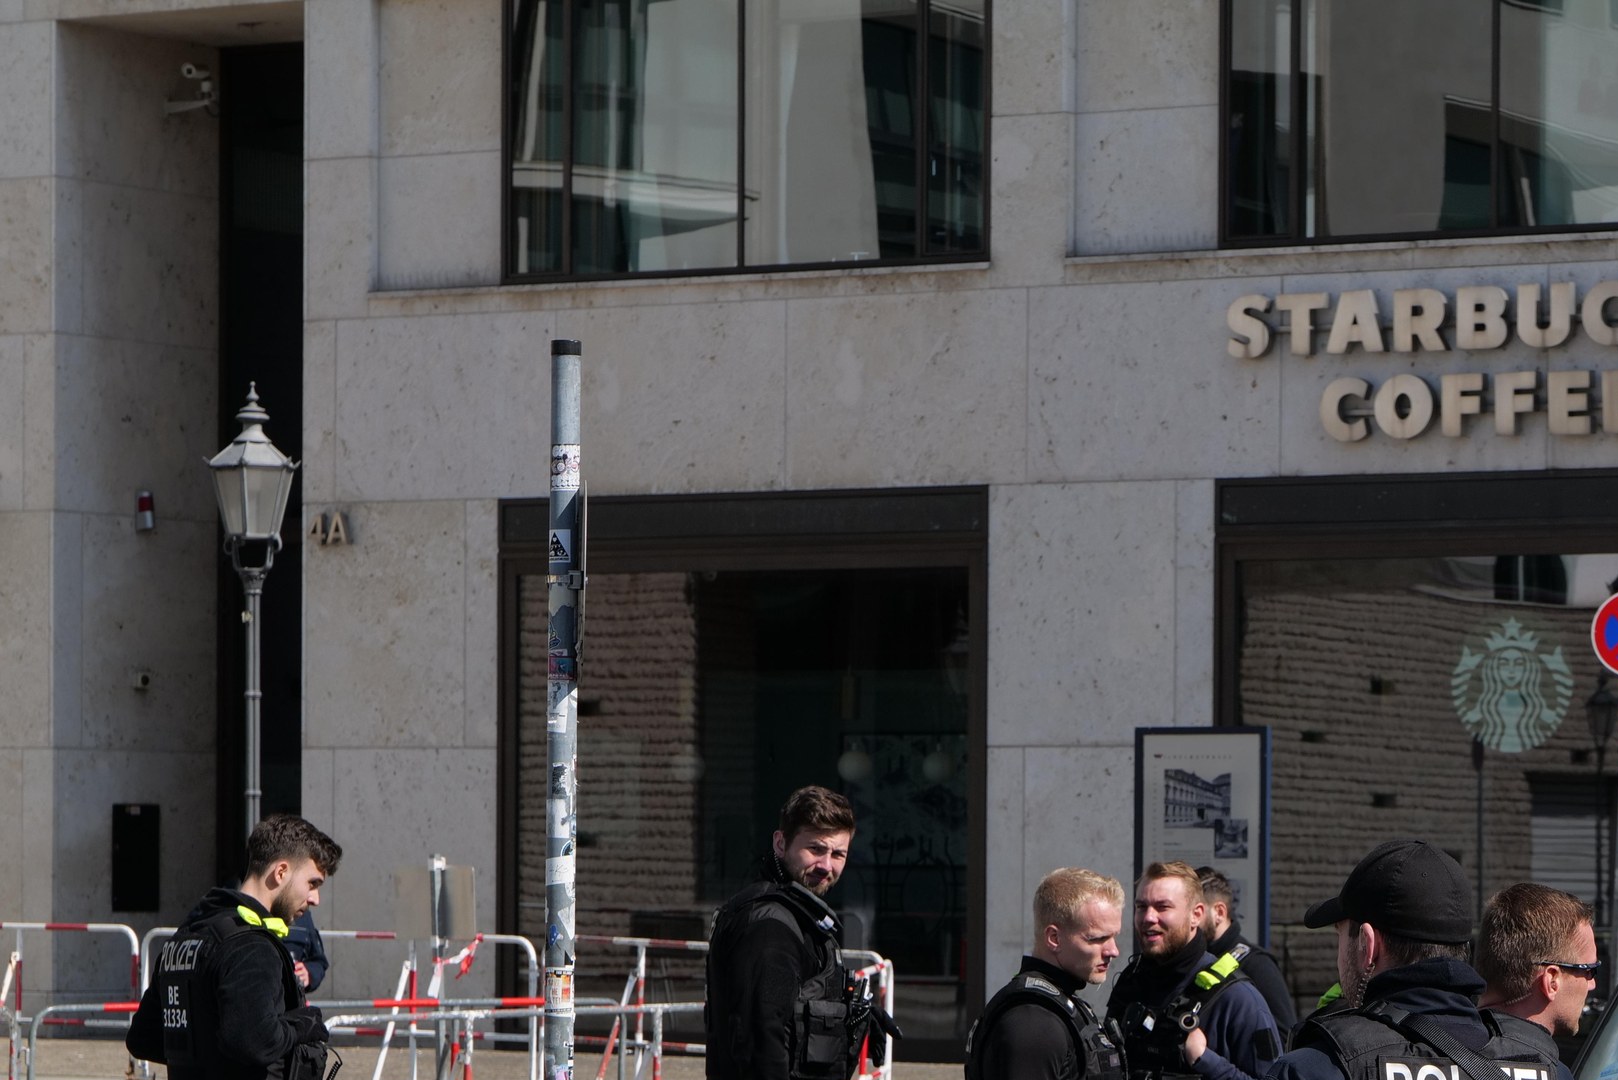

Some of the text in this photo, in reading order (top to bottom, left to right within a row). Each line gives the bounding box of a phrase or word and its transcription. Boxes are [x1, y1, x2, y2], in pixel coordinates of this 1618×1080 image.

[307, 511, 348, 545] 4A
[160, 940, 203, 972] POLIZEI
[168, 986, 179, 1005] BE
[163, 1008, 187, 1028] 31334
